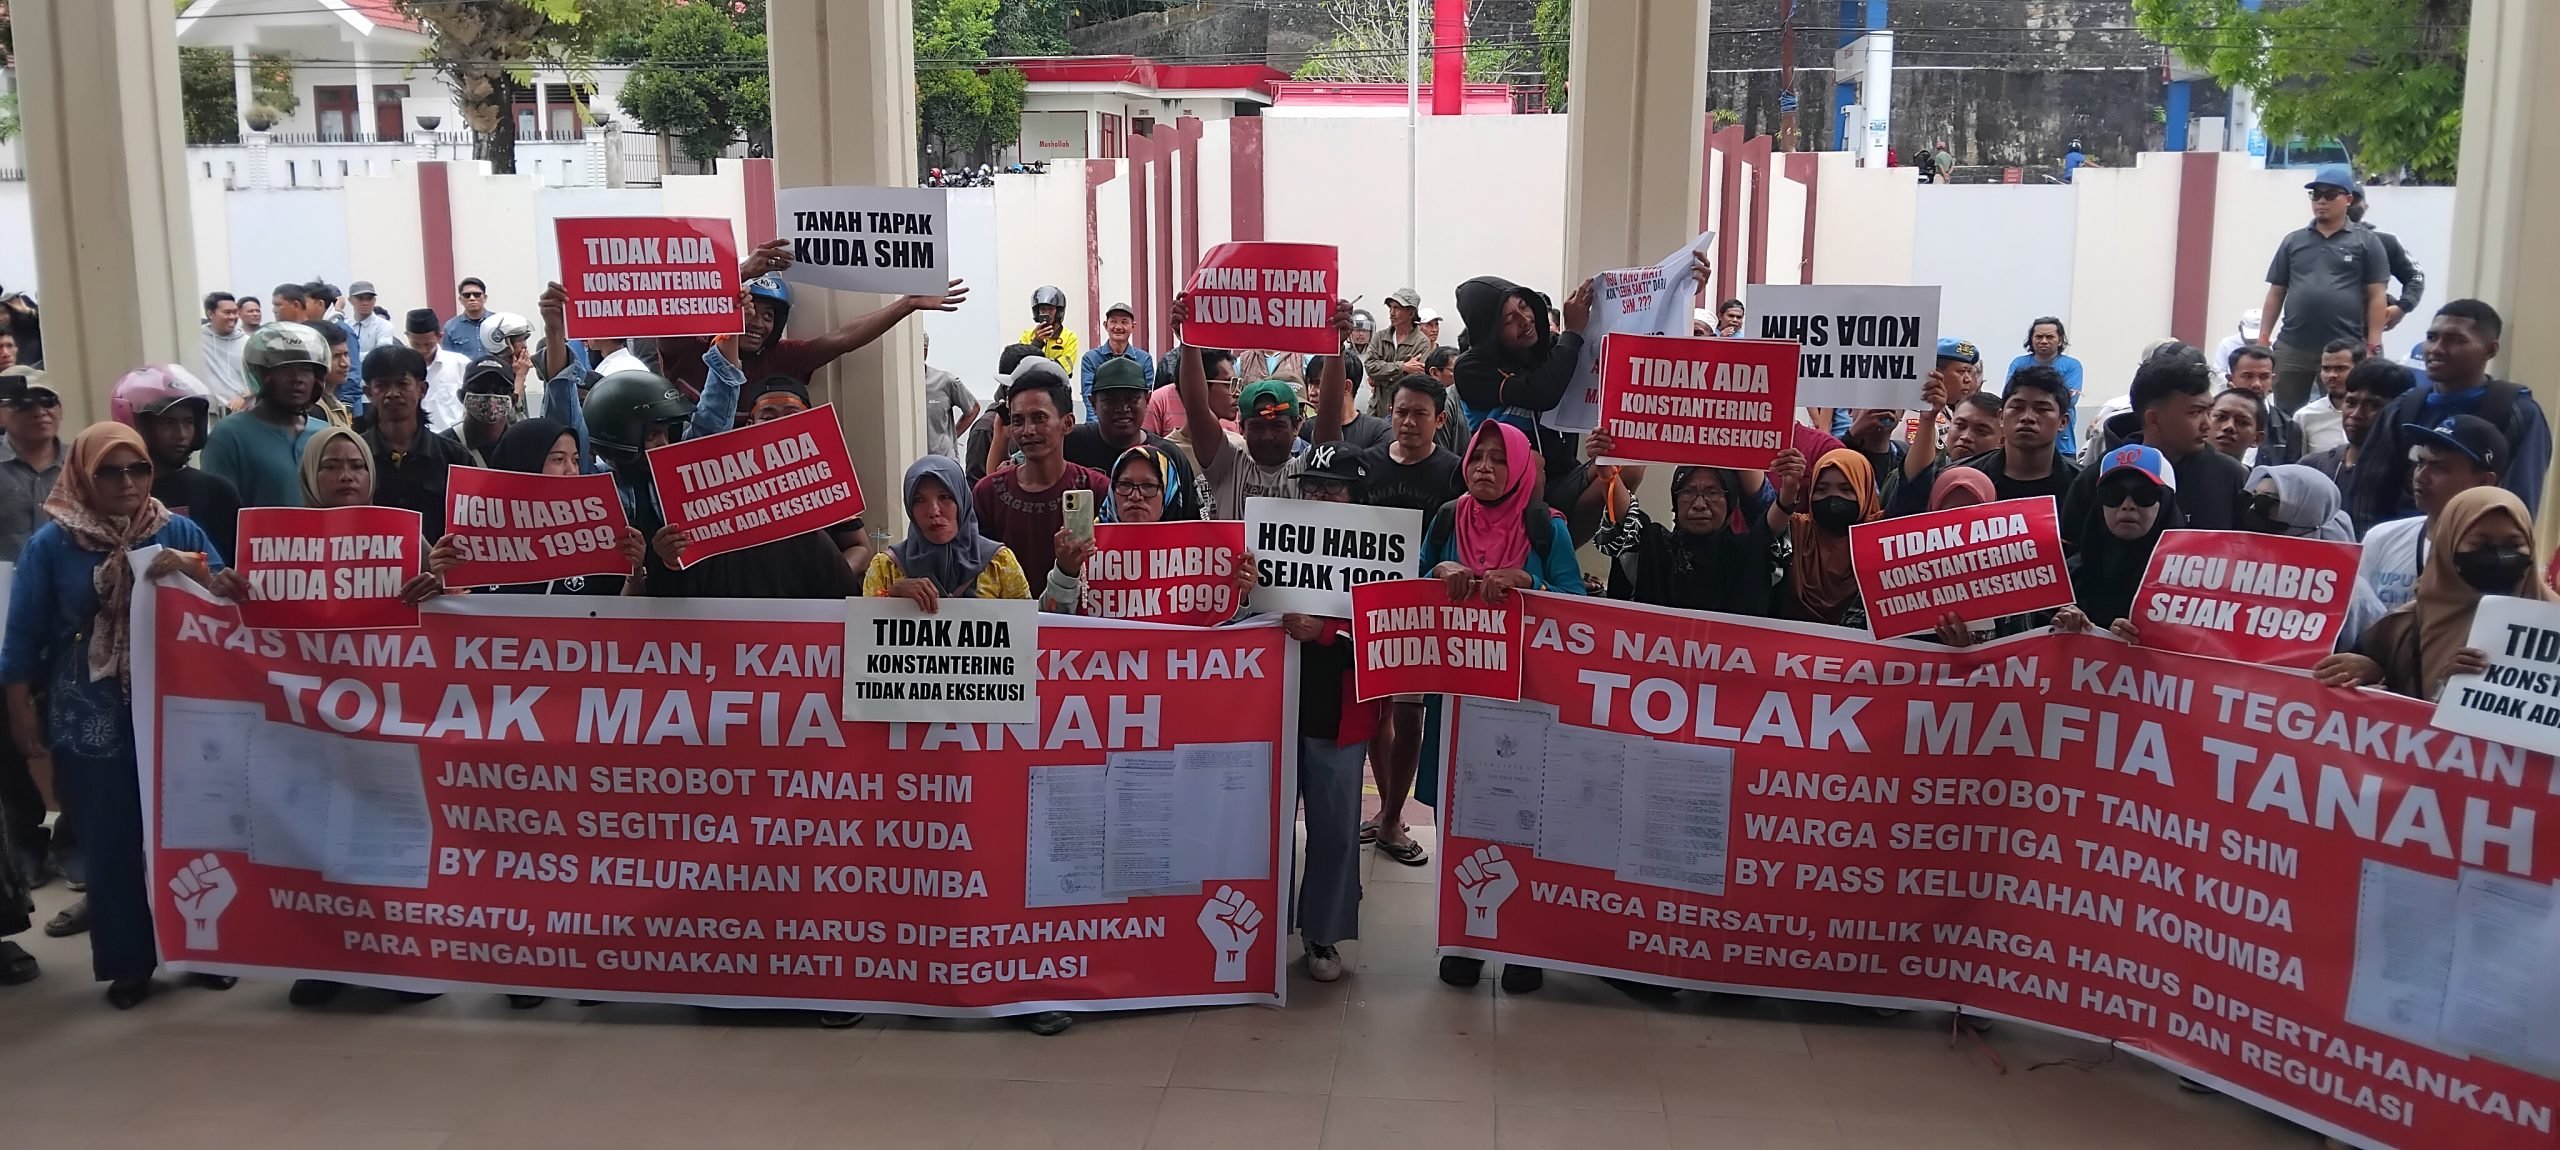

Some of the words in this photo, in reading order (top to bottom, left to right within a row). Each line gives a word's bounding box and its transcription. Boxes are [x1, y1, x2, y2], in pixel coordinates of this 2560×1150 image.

[794, 211, 861, 232] TANAH
[867, 212, 932, 235] TAPAK
[583, 238, 662, 264] TIDAK
[667, 238, 715, 263] ADA
[795, 238, 868, 266] KUDA
[875, 240, 933, 268] SHM
[583, 271, 722, 292] KONSTANTERING
[1197, 268, 1257, 290] TANAH
[1262, 269, 1326, 293] TAPAK
[575, 300, 623, 317] TIDAK
[627, 299, 658, 316] ADA
[661, 297, 733, 315] EKSEKUSI
[1195, 296, 1263, 324] KUDA
[1268, 298, 1326, 328] SHM
[1761, 315, 1829, 346] SHM
[1837, 316, 1920, 347] KUDA
[1629, 357, 1709, 390] TIDAK
[1713, 363, 1768, 393] ADA
[1841, 355, 1917, 379] TANAH
[1621, 392, 1772, 422] KONSTANTERING
[1610, 419, 1658, 440] TIDAK
[1661, 424, 1694, 443] ADA
[1699, 427, 1781, 449] EKSEKUSI
[676, 449, 762, 493] TIDAK
[763, 432, 820, 470] ADA
[682, 460, 832, 522] KONSTANTERING
[735, 508, 771, 531] ADA
[770, 481, 852, 521] EKSEKUSI
[453, 494, 505, 528] HGU
[511, 497, 607, 528] HABIS
[250, 537, 325, 562] TANAH
[330, 535, 403, 561] TAPAK
[453, 535, 538, 561] SEJAK
[539, 526, 616, 557] 1999
[1259, 523, 1315, 554] HGU
[1322, 528, 1405, 563] HABIS
[1879, 524, 1964, 561] TIDAK
[1970, 514, 2028, 544] ADA
[1089, 550, 1141, 580] HGU
[1150, 547, 1231, 579] HABIS
[1257, 559, 1333, 590] SEJAK
[1879, 539, 2038, 589] KONSTANTERING
[2159, 555, 2228, 589] HGU
[2231, 560, 2337, 603] HABIS
[249, 569, 327, 600] KUDA
[334, 567, 402, 599] SHM
[1088, 588, 1161, 617] SEJAK
[1167, 584, 1230, 613] 1999
[1876, 598, 1929, 617] TIDAK
[1932, 583, 1969, 605] ADA
[1969, 565, 2056, 598] EKSEKUSI
[873, 619, 952, 647] TIDAK
[957, 621, 1010, 648] ADA
[1367, 606, 1434, 634] TANAH
[1440, 607, 1506, 634] TAPAK
[2148, 593, 2241, 631] SEJAK
[2246, 606, 2326, 641] 1999
[176, 611, 286, 658] ATAS
[297, 632, 436, 668] NAMA
[455, 637, 716, 683] KEADILAN,
[1168, 648, 1265, 679] HAK
[1368, 636, 1441, 670] KUDA
[1448, 637, 1506, 671] SHM
[867, 655, 1014, 675] KONSTANTERING
[268, 671, 550, 741] TOLAK
[576, 688, 845, 747] MAFIA
[856, 682, 905, 699] TIDAK
[909, 683, 942, 700] ADA
[946, 683, 1024, 701] EKSEKUSI
[1613, 630, 1756, 673] NAMA
[1775, 652, 2050, 695] KEADILAN,
[2072, 658, 2194, 714] KAMI
[2213, 684, 2527, 788] TEGAKKAN
[2461, 688, 2527, 719] TIDAK
[437, 761, 577, 791] JANGAN
[590, 767, 756, 795] SEROBOT
[768, 770, 883, 800] TANAH
[897, 774, 972, 802] SHM
[1578, 669, 1873, 752] TOLAK
[1904, 700, 2174, 787] MAFIA
[2203, 737, 2535, 878] TANAH
[441, 804, 567, 835] WARGA
[577, 811, 739, 843] SEGITIGA
[751, 817, 863, 846] TAPAK
[877, 820, 972, 850] KUDA
[1748, 769, 1899, 803] JANGAN
[1912, 778, 2085, 817] SEROBOT
[2097, 794, 2209, 852] TANAH
[2220, 829, 2297, 879] SHM
[439, 847, 485, 876] BY
[496, 851, 578, 882] PASS
[590, 856, 799, 891] KELURAHAN
[814, 866, 988, 898] KORUMBA
[1745, 813, 1877, 848] WARGA
[1889, 823, 2062, 864] SEGITIGA
[2076, 840, 2185, 896] TAPAK
[2196, 874, 2292, 932] KUDA
[270, 888, 375, 918] WARGA
[385, 901, 535, 936] BERSATU,
[547, 911, 635, 936] MILIK
[644, 917, 764, 939] WARGA
[776, 920, 886, 942] HARUS
[898, 917, 1164, 948] DIPERTAHANKAN
[1735, 858, 1784, 887] BY
[1796, 864, 1884, 893] PASS
[1898, 869, 2123, 926] KELURAHAN
[2136, 904, 2304, 991] KORUMBA
[344, 931, 421, 956] PARA
[431, 939, 586, 968] PENGADIL
[597, 950, 757, 973] GUNAKAN
[770, 955, 842, 976] HATI
[856, 957, 917, 981] DAN
[930, 956, 1087, 984] REGULASI
[1531, 881, 1645, 918] WARGA
[1657, 901, 1815, 941] BERSATU,
[1829, 919, 1922, 942] MILIK
[1933, 924, 2056, 963] WARGA
[2068, 946, 2180, 996] HARUS
[2193, 983, 2552, 1133] DIPERTAHANKAN
[1628, 931, 1711, 960] PARA
[1723, 944, 1887, 973] PENGADIL
[1900, 956, 2069, 1003] GUNAKAN
[2081, 987, 2156, 1028] HATI
[2168, 1012, 2229, 1055] DAN
[2242, 1038, 2413, 1126] REGULASI
